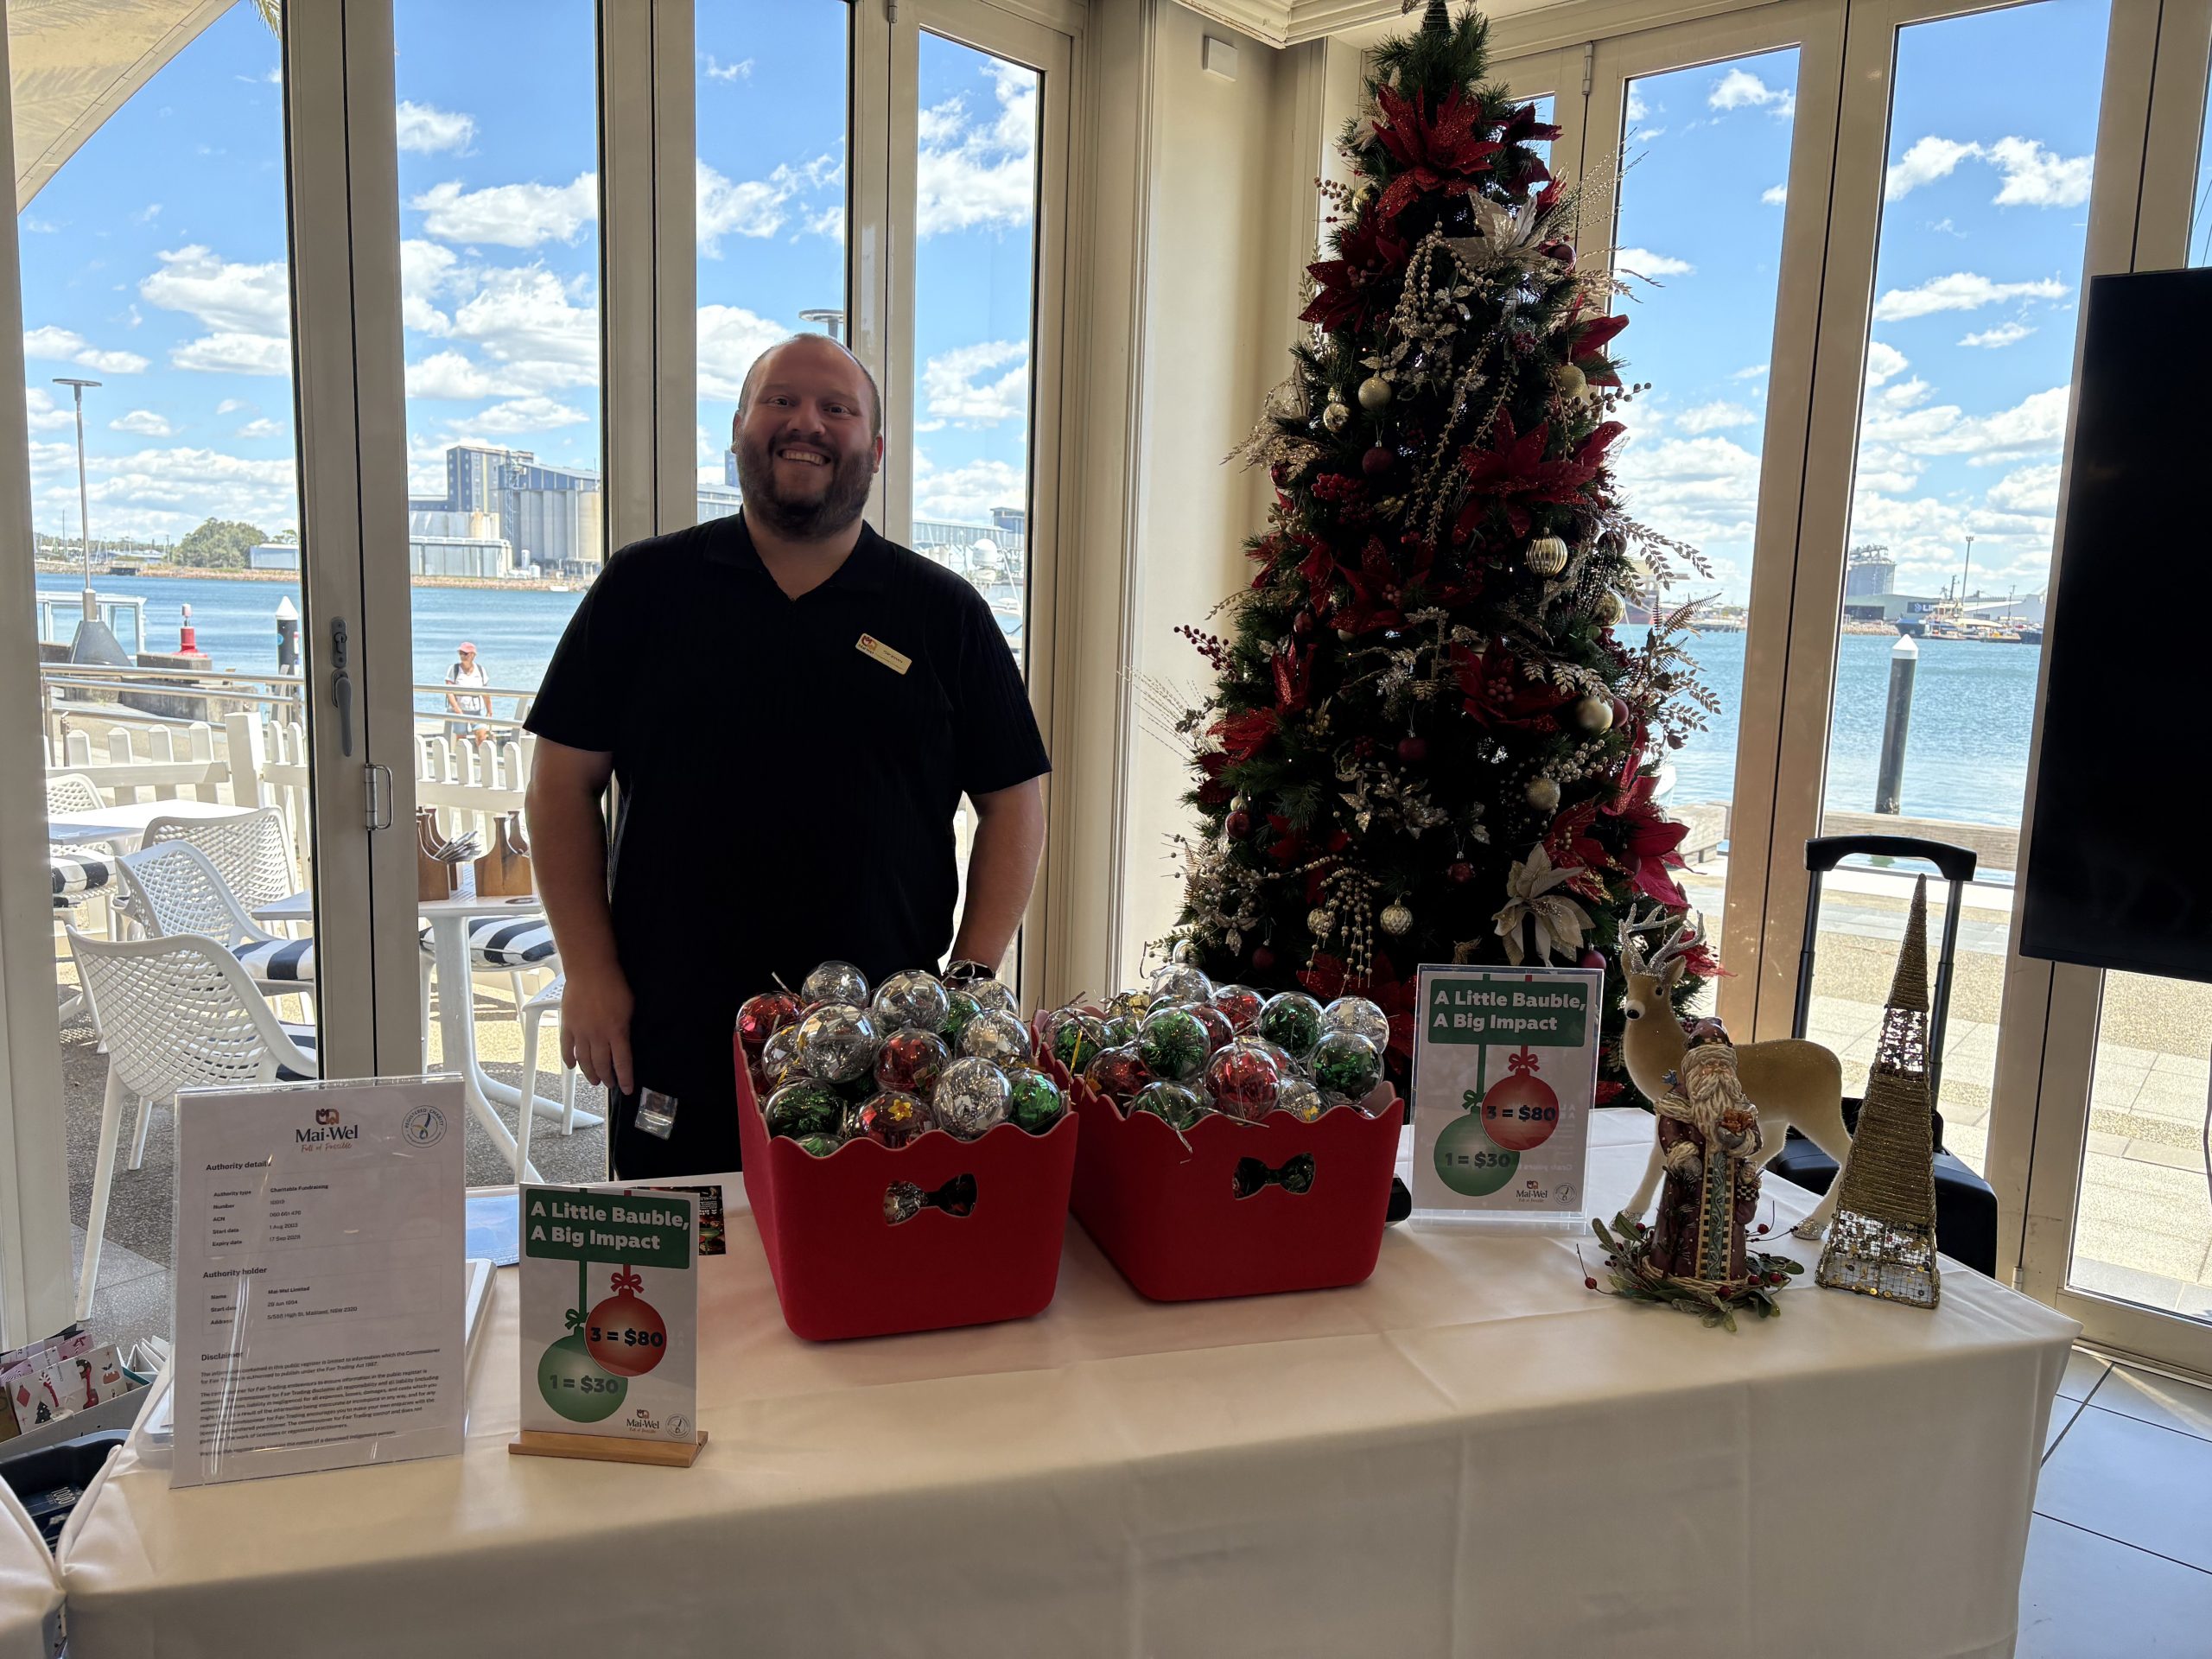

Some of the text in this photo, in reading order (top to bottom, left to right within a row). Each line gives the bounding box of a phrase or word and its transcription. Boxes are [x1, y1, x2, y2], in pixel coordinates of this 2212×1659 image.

[1434, 990, 1586, 1011] A Little Bauble,
[1433, 1013, 1558, 1033] A Big Impact
[1486, 1105, 1497, 1120] 3
[1518, 1105, 1555, 1122] $80
[206, 1162, 242, 1171] Authority
[1445, 1153, 1452, 1166] 1
[1474, 1151, 1510, 1168] $30
[531, 1201, 690, 1230] A Little Bauble,
[531, 1224, 660, 1250] A Big Impact
[203, 1266, 267, 1279] Authority holder
[590, 1326, 601, 1342] 3
[624, 1328, 664, 1347] $80
[550, 1375, 557, 1389] 1
[581, 1376, 619, 1394] $30
